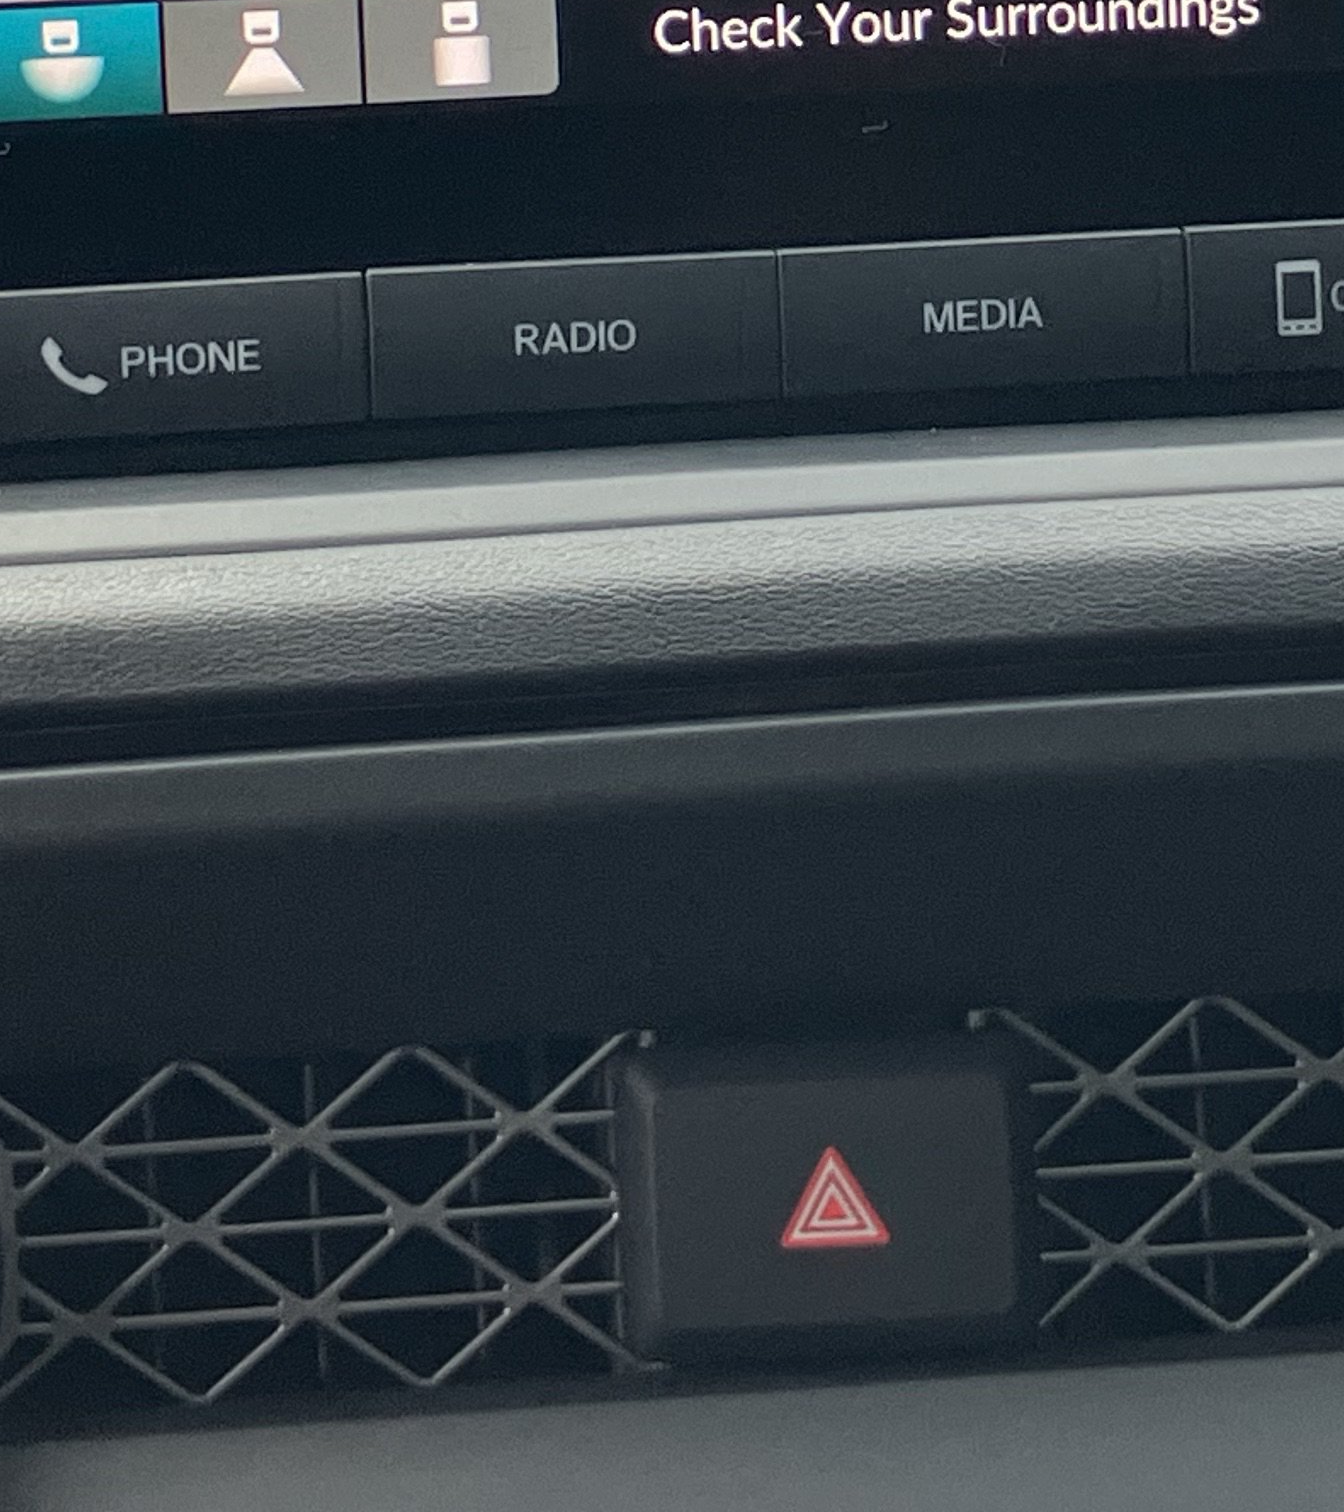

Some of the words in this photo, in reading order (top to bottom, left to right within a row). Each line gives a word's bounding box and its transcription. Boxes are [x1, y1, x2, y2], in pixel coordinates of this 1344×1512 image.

[653, 2, 803, 54] Check
[816, 1, 933, 45] Your
[922, 296, 1044, 334] MEDIA
[514, 319, 638, 356] RADIO
[120, 339, 262, 379] PHONE
